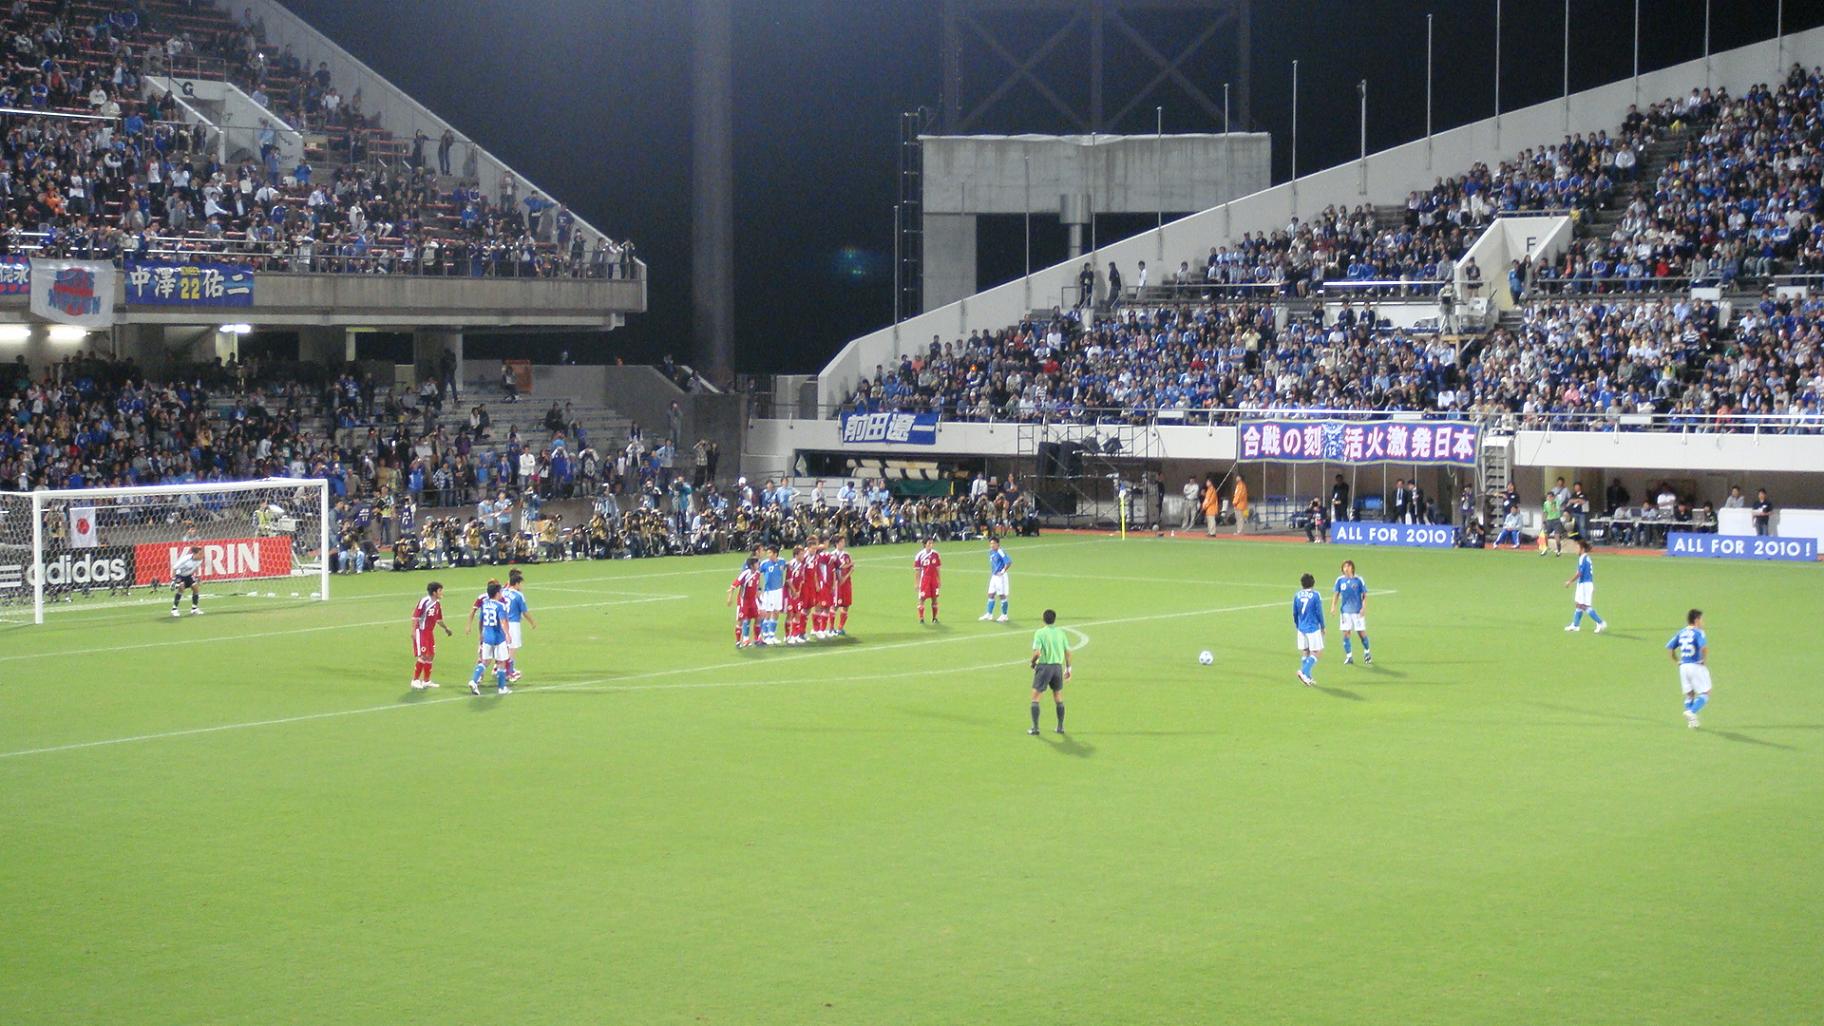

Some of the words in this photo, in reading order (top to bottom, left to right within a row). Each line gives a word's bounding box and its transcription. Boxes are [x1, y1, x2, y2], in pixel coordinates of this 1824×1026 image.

[181, 81, 194, 96] G
[1526, 236, 1537, 253] F
[180, 278, 200, 299] 22
[203, 268, 250, 298] 佑二
[1336, 526, 1363, 541] ALL
[1369, 527, 1398, 542] FOR
[1674, 538, 1704, 553] ALL
[1711, 539, 1745, 555] FOR
[169, 542, 260, 578] KRIN
[26, 553, 126, 586] adidas
[1300, 597, 1309, 615] 7
[482, 607, 499, 627] 33
